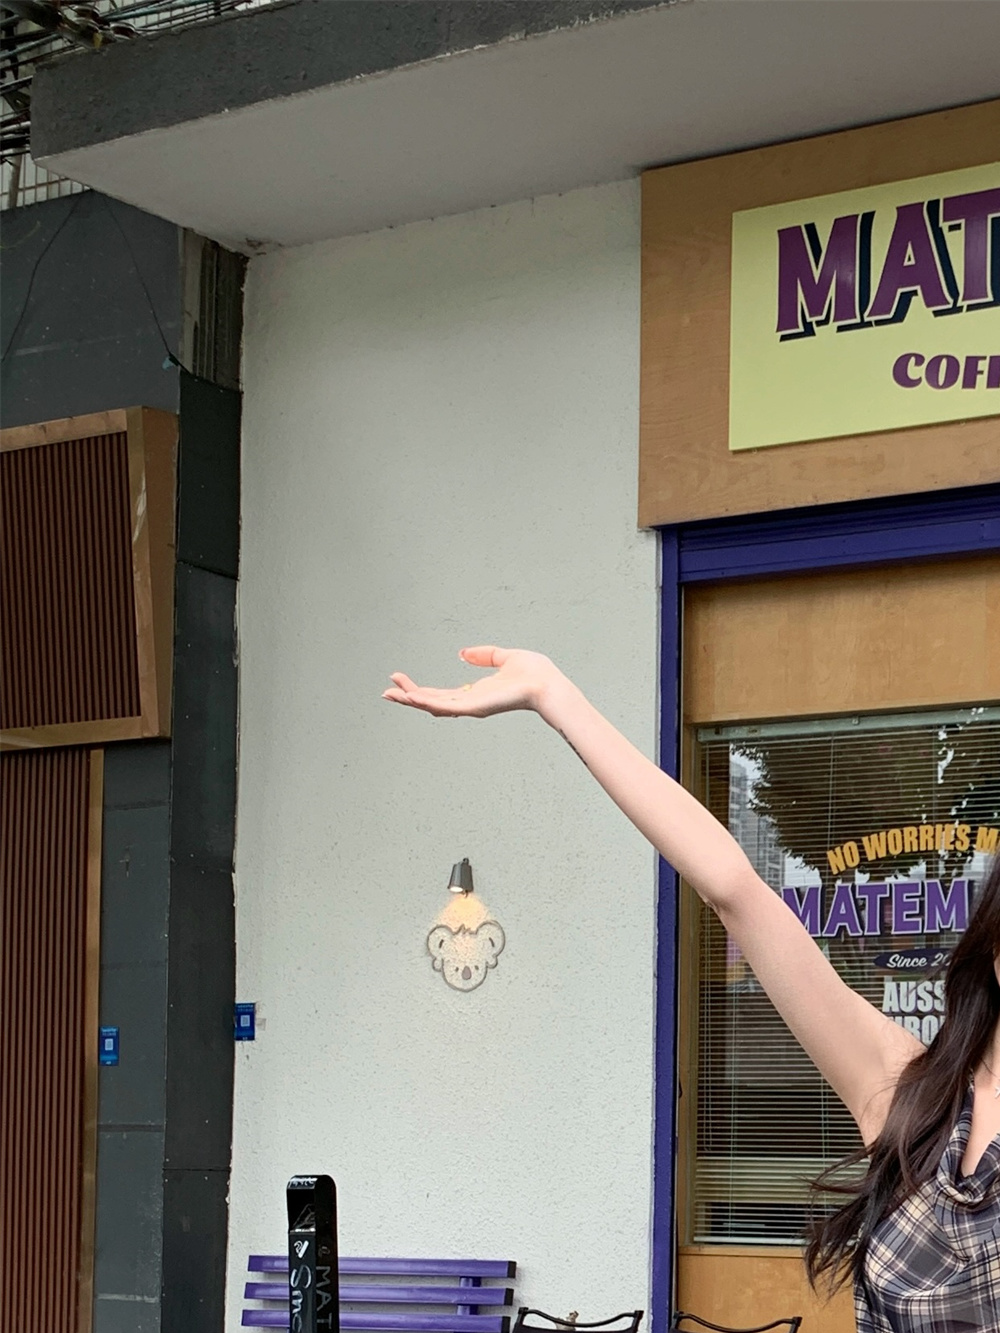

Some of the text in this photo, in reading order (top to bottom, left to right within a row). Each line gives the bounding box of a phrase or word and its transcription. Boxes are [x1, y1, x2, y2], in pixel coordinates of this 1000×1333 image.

[826, 841, 861, 875] NO
[862, 823, 972, 862] WORRIES
[887, 953, 927, 970] Since
